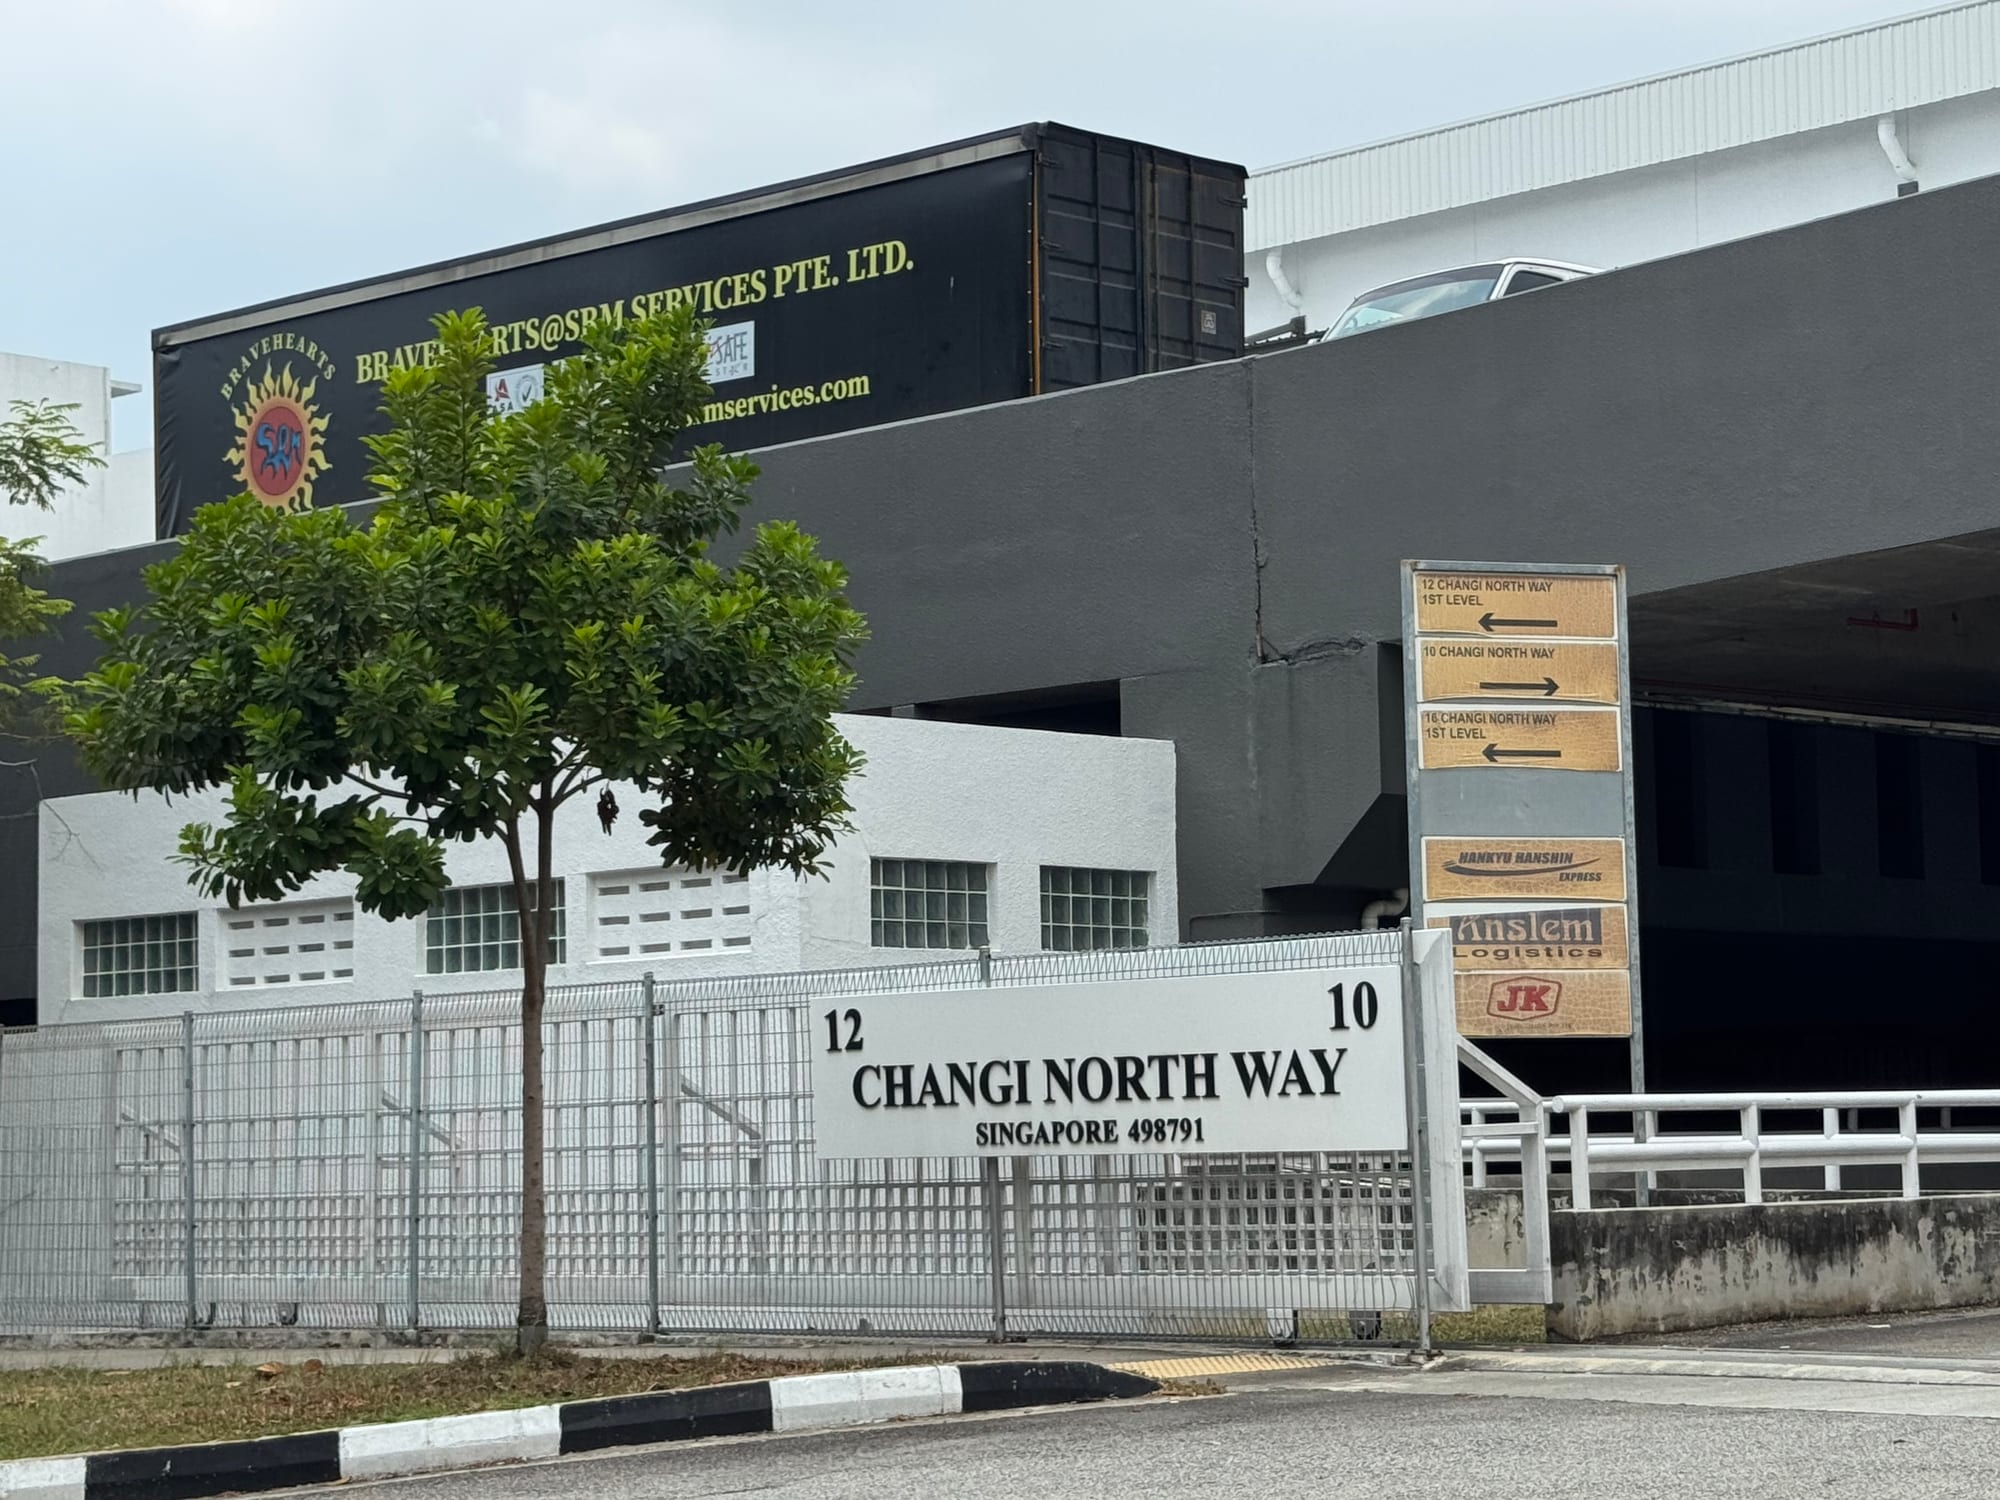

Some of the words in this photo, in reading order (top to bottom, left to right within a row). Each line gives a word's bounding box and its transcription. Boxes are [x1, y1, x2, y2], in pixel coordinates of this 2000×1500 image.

[355, 299, 625, 384] BRAVERTS@SRM
[631, 269, 767, 322] SERVICES
[774, 256, 838, 297] PTE.
[847, 240, 914, 283] LTD.
[220, 333, 336, 400] BRAVEHEARTS
[1422, 578, 1434, 590] 12
[1437, 578, 1482, 591] CHANGI
[1485, 580, 1525, 592] NORTH
[1528, 582, 1553, 592] WAY
[1422, 594, 1443, 605] 1ST
[1446, 594, 1483, 606] LEVEL
[1424, 646, 1435, 657] 10
[1439, 646, 1484, 658] CHANGI
[1487, 647, 1527, 659] NORTH
[1530, 648, 1555, 659] WAY
[1426, 713, 1438, 723] 16
[1440, 712, 1486, 724] CHANGI
[1489, 713, 1529, 725] NORTH
[1531, 714, 1557, 726] WAY
[1426, 728, 1446, 739] 1ST
[1449, 728, 1486, 739] LEVEL
[1458, 851, 1512, 864] HANKYU
[1514, 852, 1573, 864] HANSHIN
[1559, 872, 1602, 882] EXPRESS
[1453, 946, 1602, 960] Logistics
[1327, 980, 1378, 1031] 10
[1496, 985, 1551, 1012] JK
[824, 1008, 864, 1052] 12
[852, 1060, 1031, 1108] CHANGI
[1043, 1052, 1219, 1105] NORTH
[1230, 1047, 1348, 1098] WAY
[975, 1119, 1119, 1147] SINGAPORE
[1127, 1117, 1205, 1143] 498791
